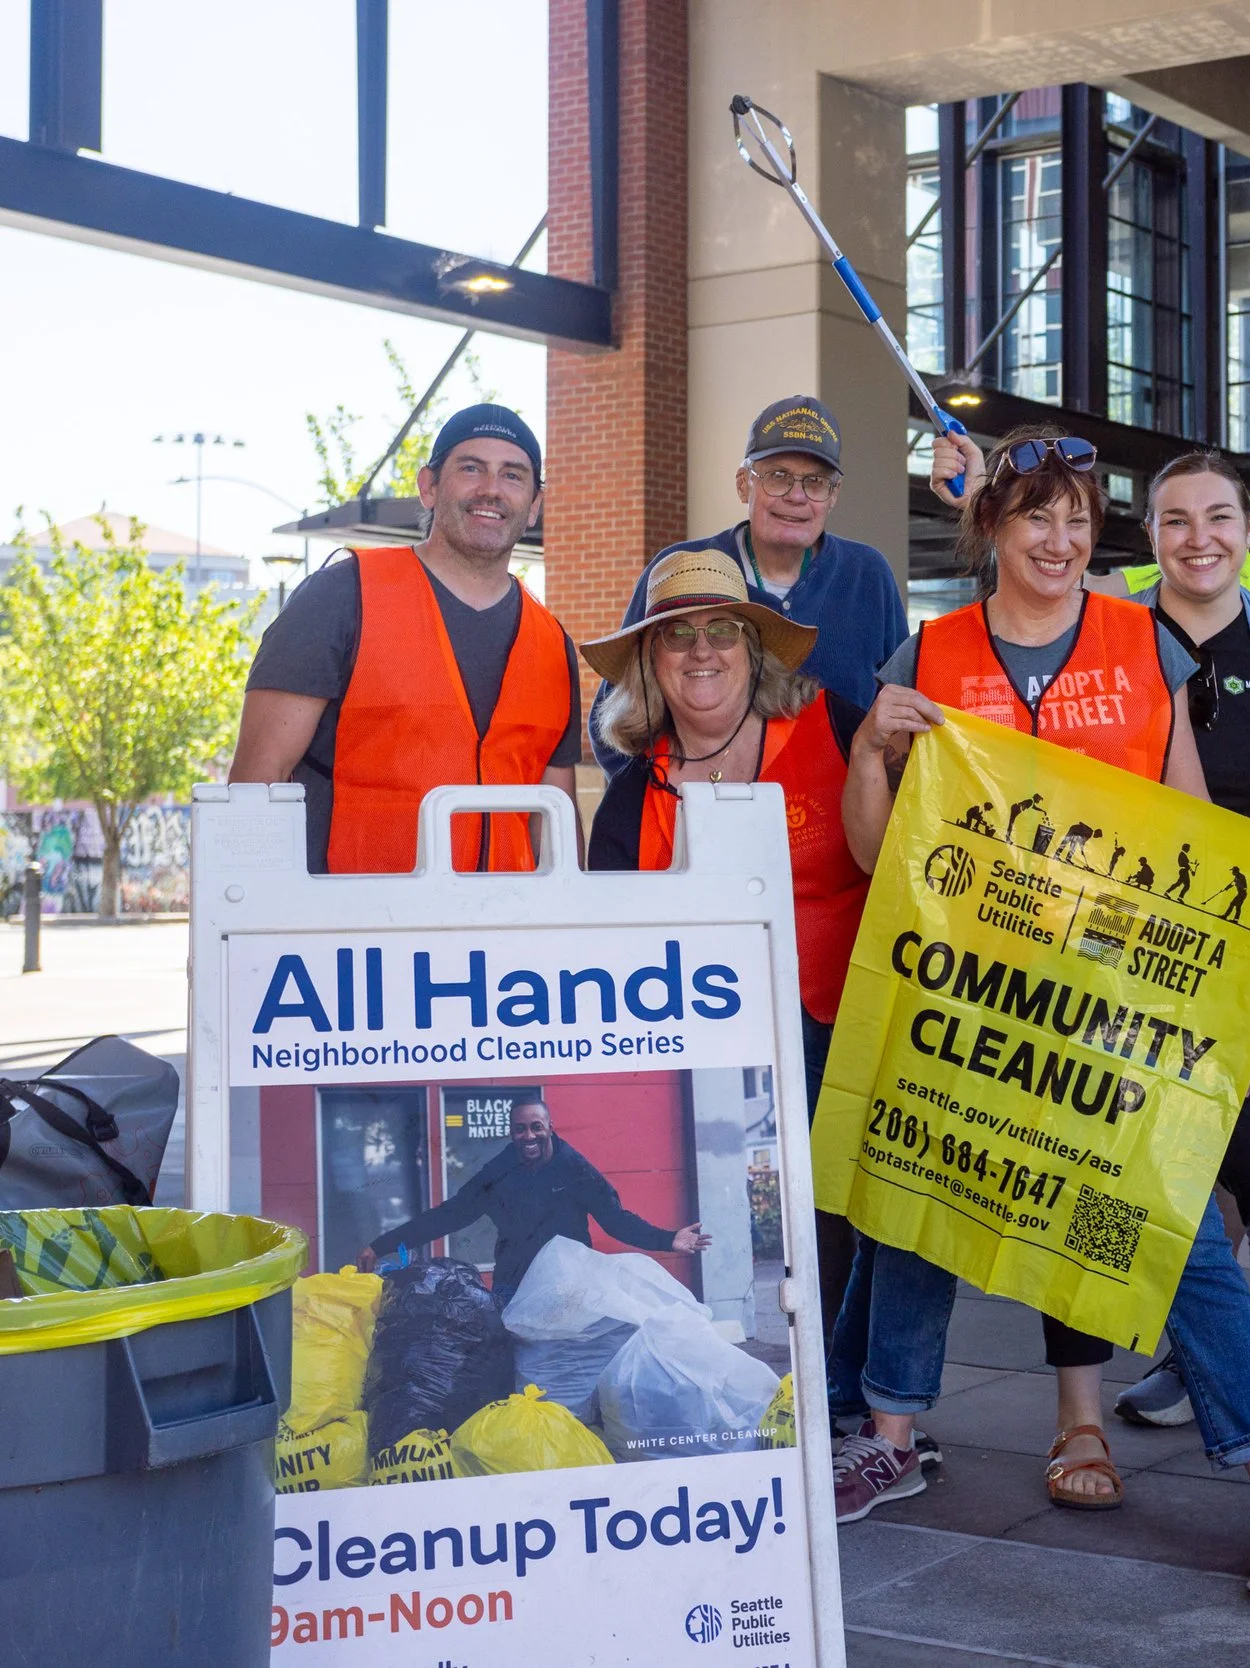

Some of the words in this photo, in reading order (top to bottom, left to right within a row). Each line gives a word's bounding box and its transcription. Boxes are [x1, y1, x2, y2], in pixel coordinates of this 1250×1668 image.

[1026, 669, 1105, 701] ADOPT
[1114, 665, 1132, 693] A
[1031, 694, 1126, 731] STREET
[983, 881, 1042, 917] Public
[989, 859, 1063, 899] Seattle
[976, 903, 1055, 947] Utilities
[1138, 914, 1211, 963] ADOPT
[1207, 938, 1226, 970] A
[252, 946, 384, 1035] All
[413, 939, 743, 1030] Hands
[1127, 949, 1207, 998] STREET
[891, 930, 1218, 1082] COMMUNITY
[252, 1036, 467, 1072] Neighborhood
[476, 1033, 593, 1063] Cleanup
[600, 1030, 685, 1057] Series
[909, 1008, 1147, 1126] CLEANUP
[466, 1099, 513, 1113] BLACK
[896, 1075, 1123, 1178] seattle.gov/utilities/aas
[941, 1133, 1067, 1211] 684-7647
[626, 1438, 666, 1449] WHITE
[669, 1433, 718, 1446] CENTER
[721, 1427, 778, 1441] CLEANUP
[273, 1520, 556, 1586] Cleanup
[570, 1477, 787, 1555] Today!
[270, 1590, 513, 1647] 9am-Noon
[730, 1596, 783, 1614] Seattle
[732, 1614, 776, 1631] Public
[733, 1631, 791, 1648] Utilities
